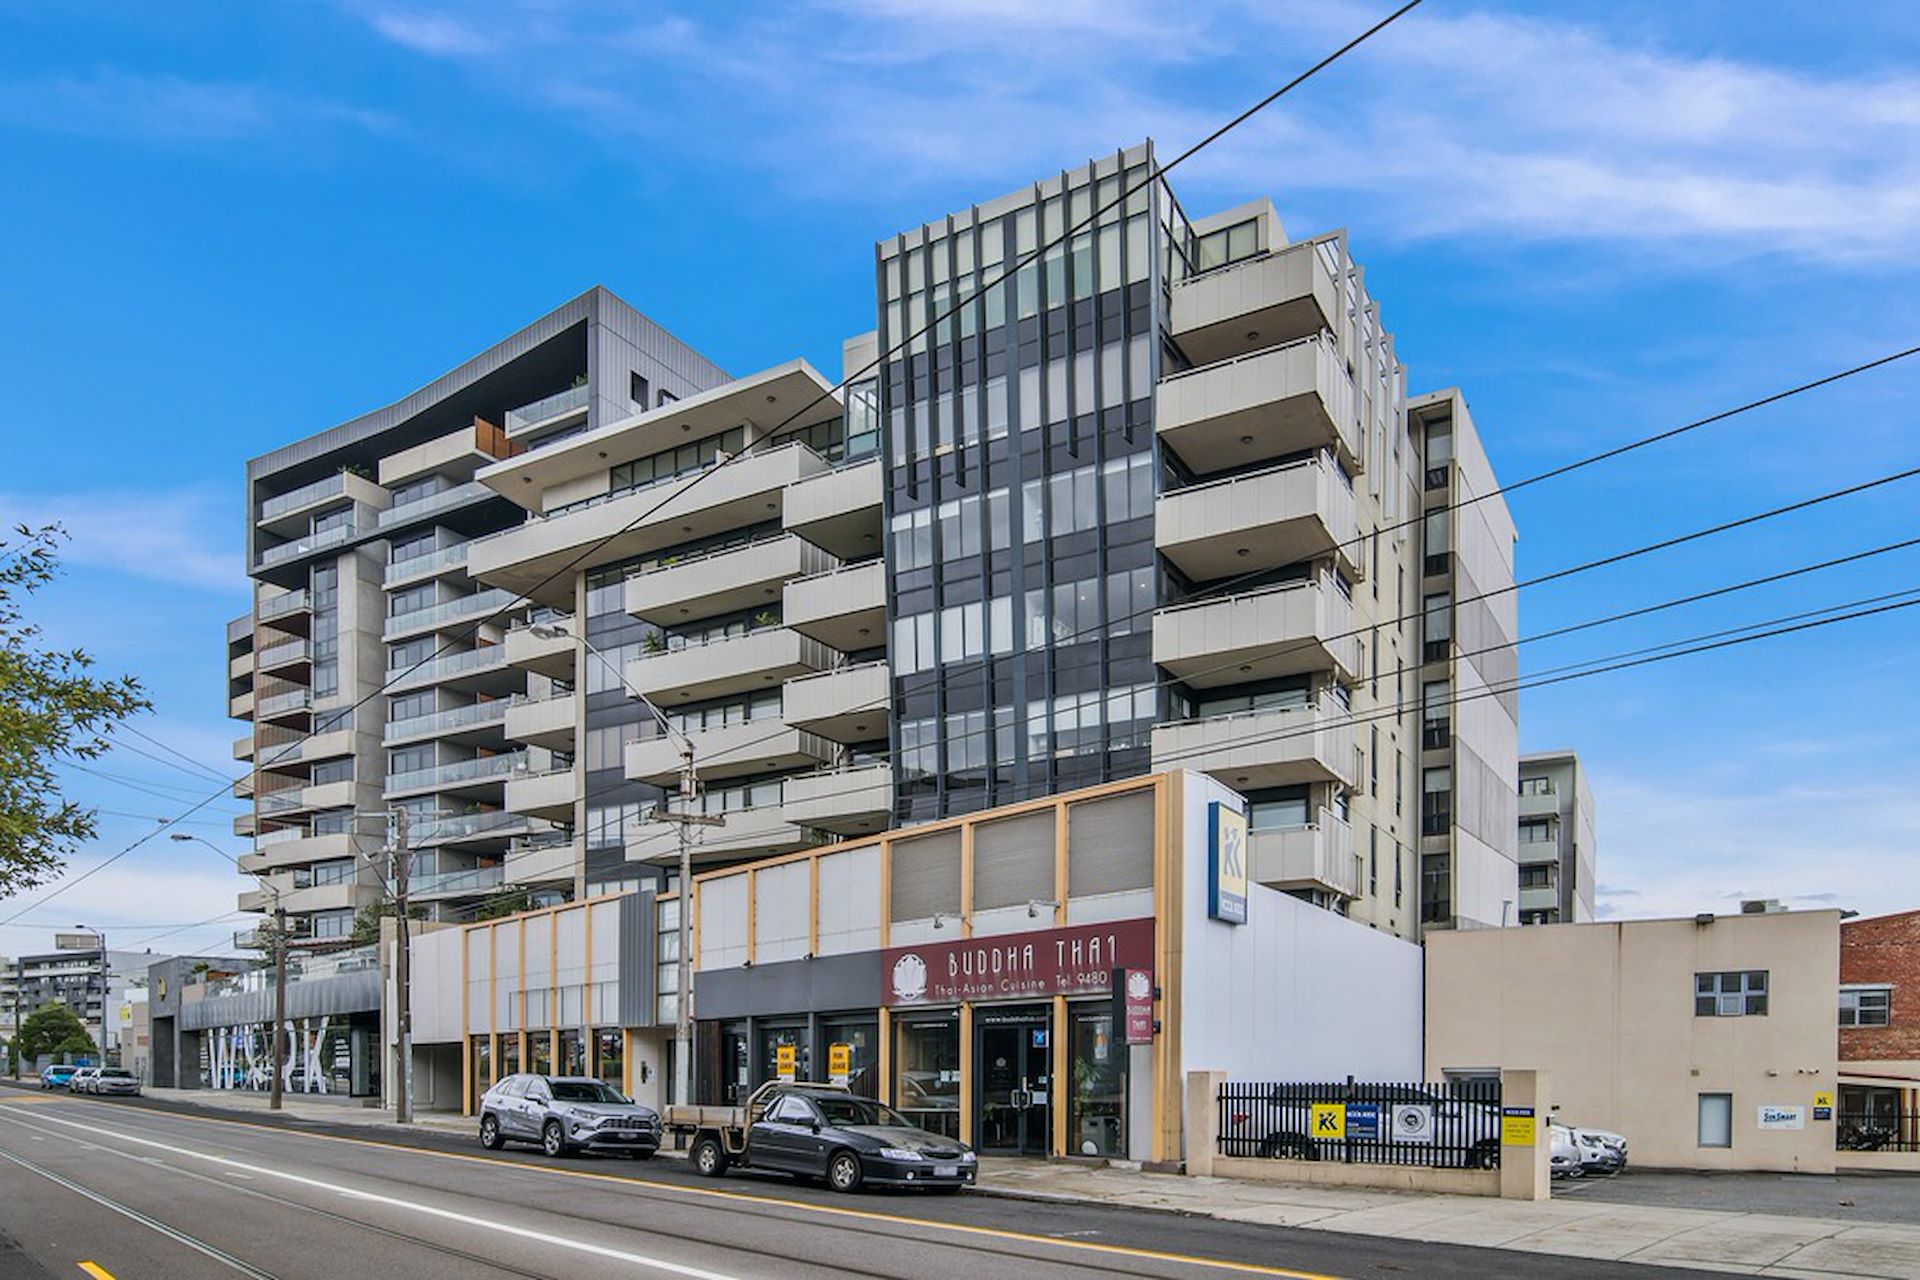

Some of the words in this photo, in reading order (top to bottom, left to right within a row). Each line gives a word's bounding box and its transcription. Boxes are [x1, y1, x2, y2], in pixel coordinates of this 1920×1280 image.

[949, 944, 1034, 977] BUDDHA
[1056, 935, 1116, 967] THAI
[935, 982, 994, 996] Thai-Asian
[1000, 979, 1046, 992] Cuisine
[1077, 971, 1107, 986] 9480
